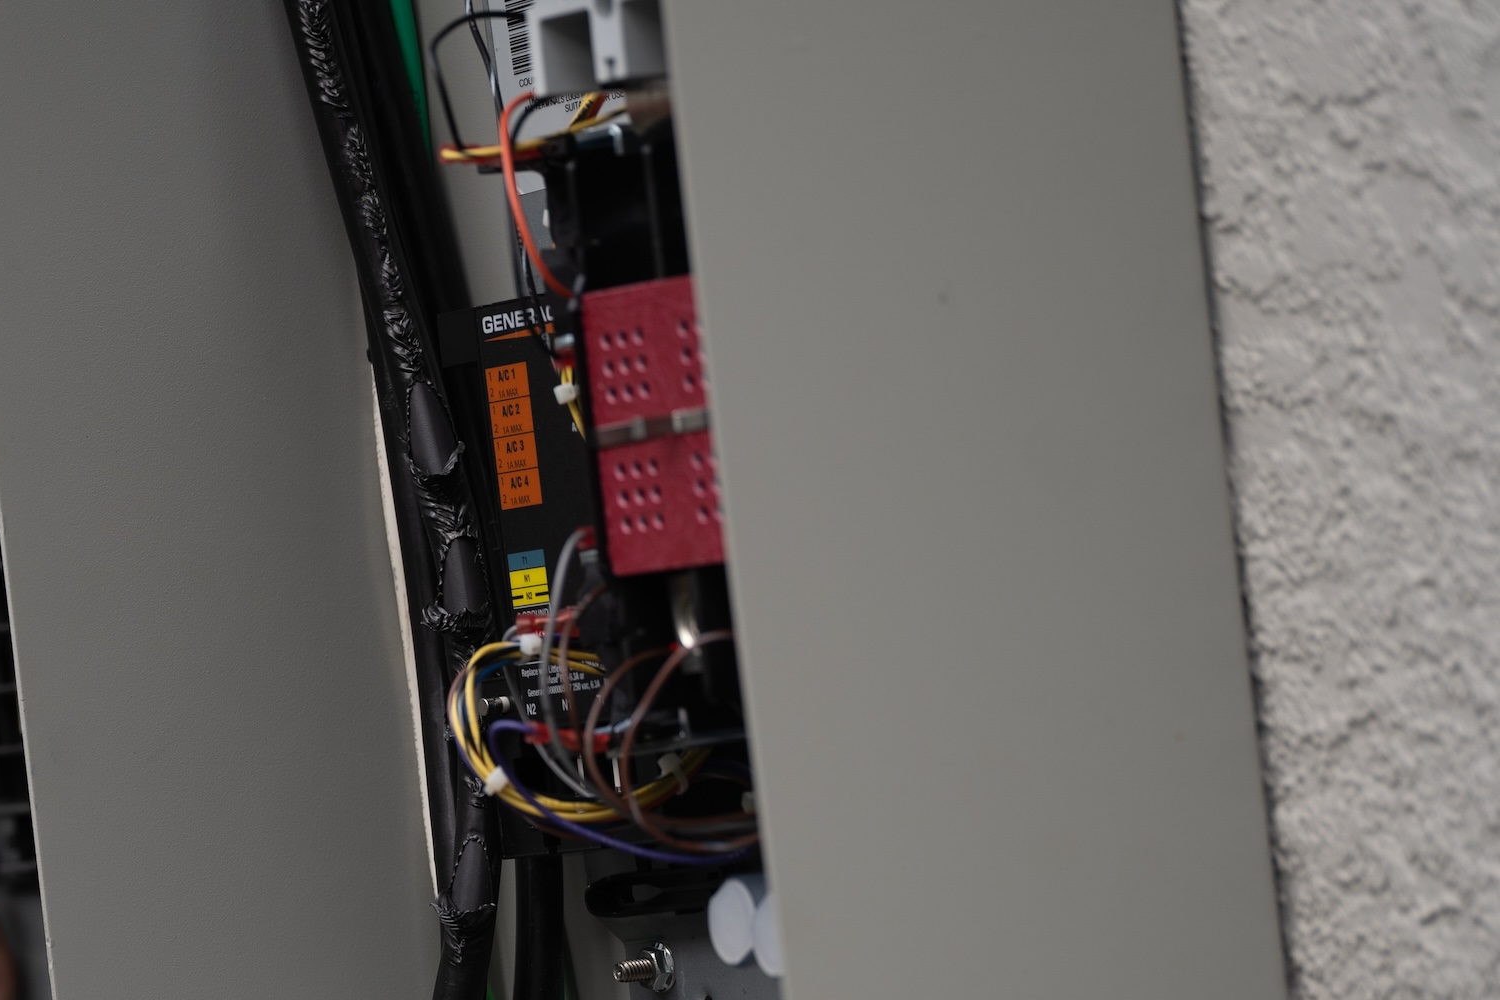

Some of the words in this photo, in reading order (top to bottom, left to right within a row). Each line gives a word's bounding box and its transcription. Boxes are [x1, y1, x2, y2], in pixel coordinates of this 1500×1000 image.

[498, 369, 510, 382] A/C
[511, 367, 516, 379] 1
[490, 387, 494, 397] 2
[506, 387, 519, 397] MAX
[502, 405, 514, 418] A/C
[515, 403, 520, 415] 2
[494, 424, 499, 433] 2
[510, 423, 523, 433] MAX
[506, 441, 518, 454] A/C
[519, 439, 525, 451] 3
[498, 458, 503, 468] 2
[514, 458, 527, 468] MAX
[510, 476, 522, 490] A/C
[524, 475, 529, 487] 4
[503, 494, 508, 504] 2
[518, 494, 531, 504] MAX
[521, 556, 528, 565] T1
[523, 574, 531, 583] N1
[525, 591, 533, 600] N2
[521, 668, 539, 679] Replace
[527, 688, 544, 697] Genera
[526, 703, 537, 716] N2
